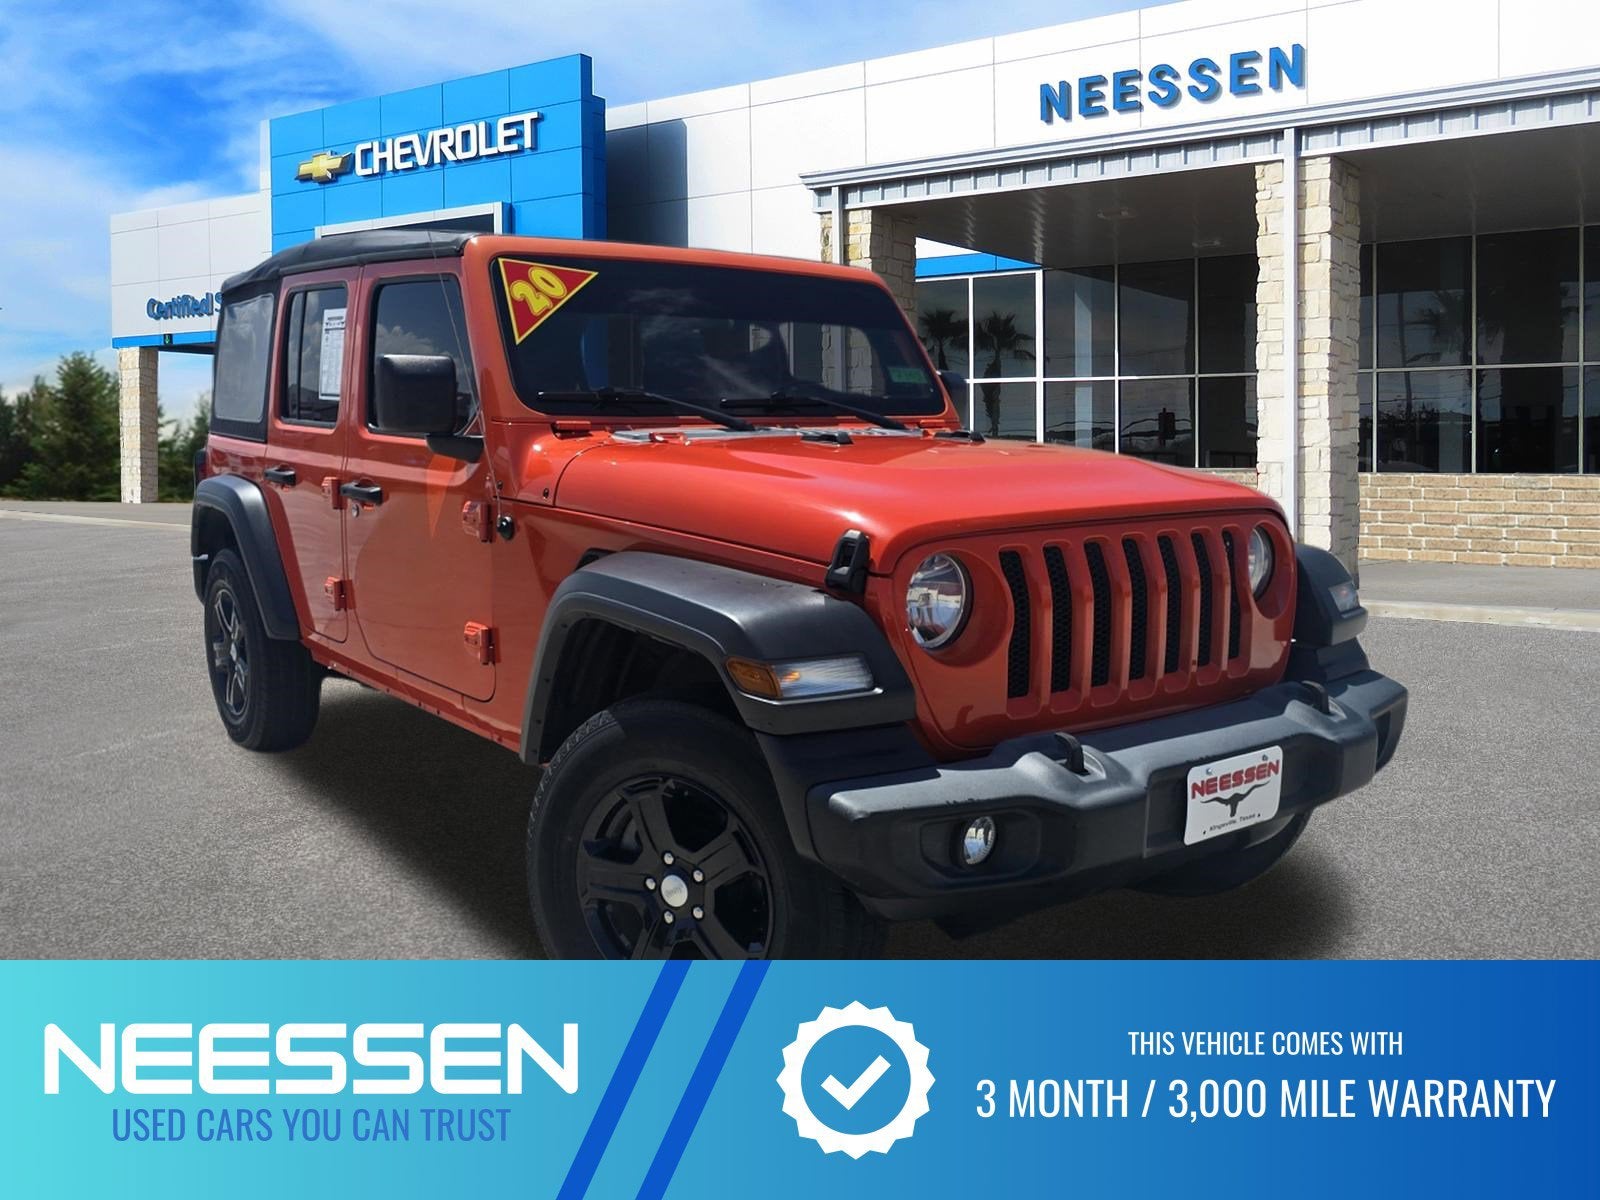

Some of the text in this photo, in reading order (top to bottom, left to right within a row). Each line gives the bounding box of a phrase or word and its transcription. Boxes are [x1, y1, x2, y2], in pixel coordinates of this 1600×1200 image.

[1039, 43, 1307, 125] NEESSEN
[355, 111, 542, 177] CHEVROLET
[146, 292, 214, 320] Certified
[510, 266, 567, 317] 20
[1191, 759, 1280, 800] NEESSEN
